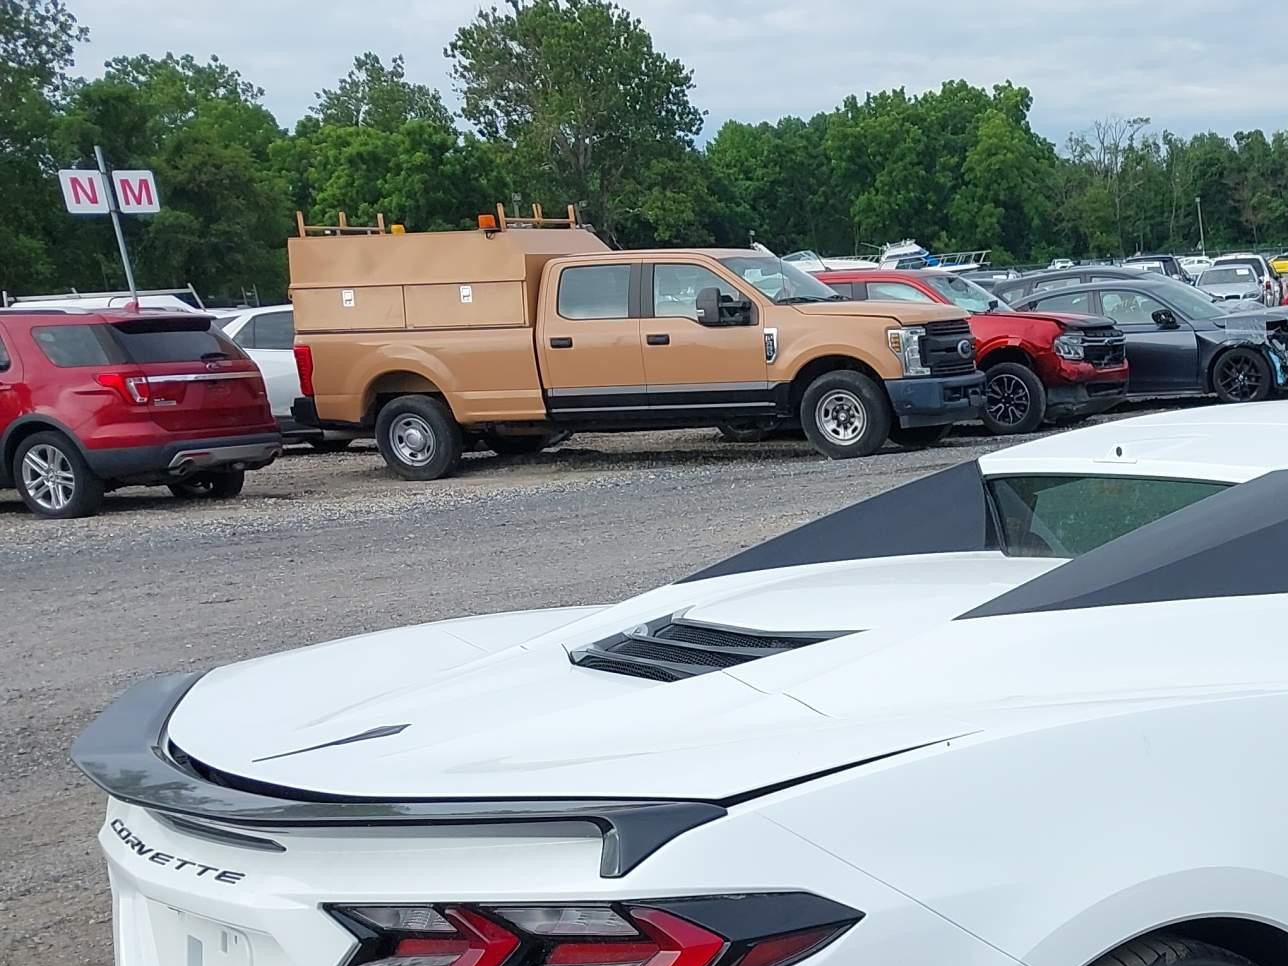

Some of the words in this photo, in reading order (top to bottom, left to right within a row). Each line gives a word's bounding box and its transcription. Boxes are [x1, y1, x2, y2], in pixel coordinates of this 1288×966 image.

[69, 176, 99, 204] N
[119, 178, 154, 206] M
[110, 818, 247, 885] CORVETTE
